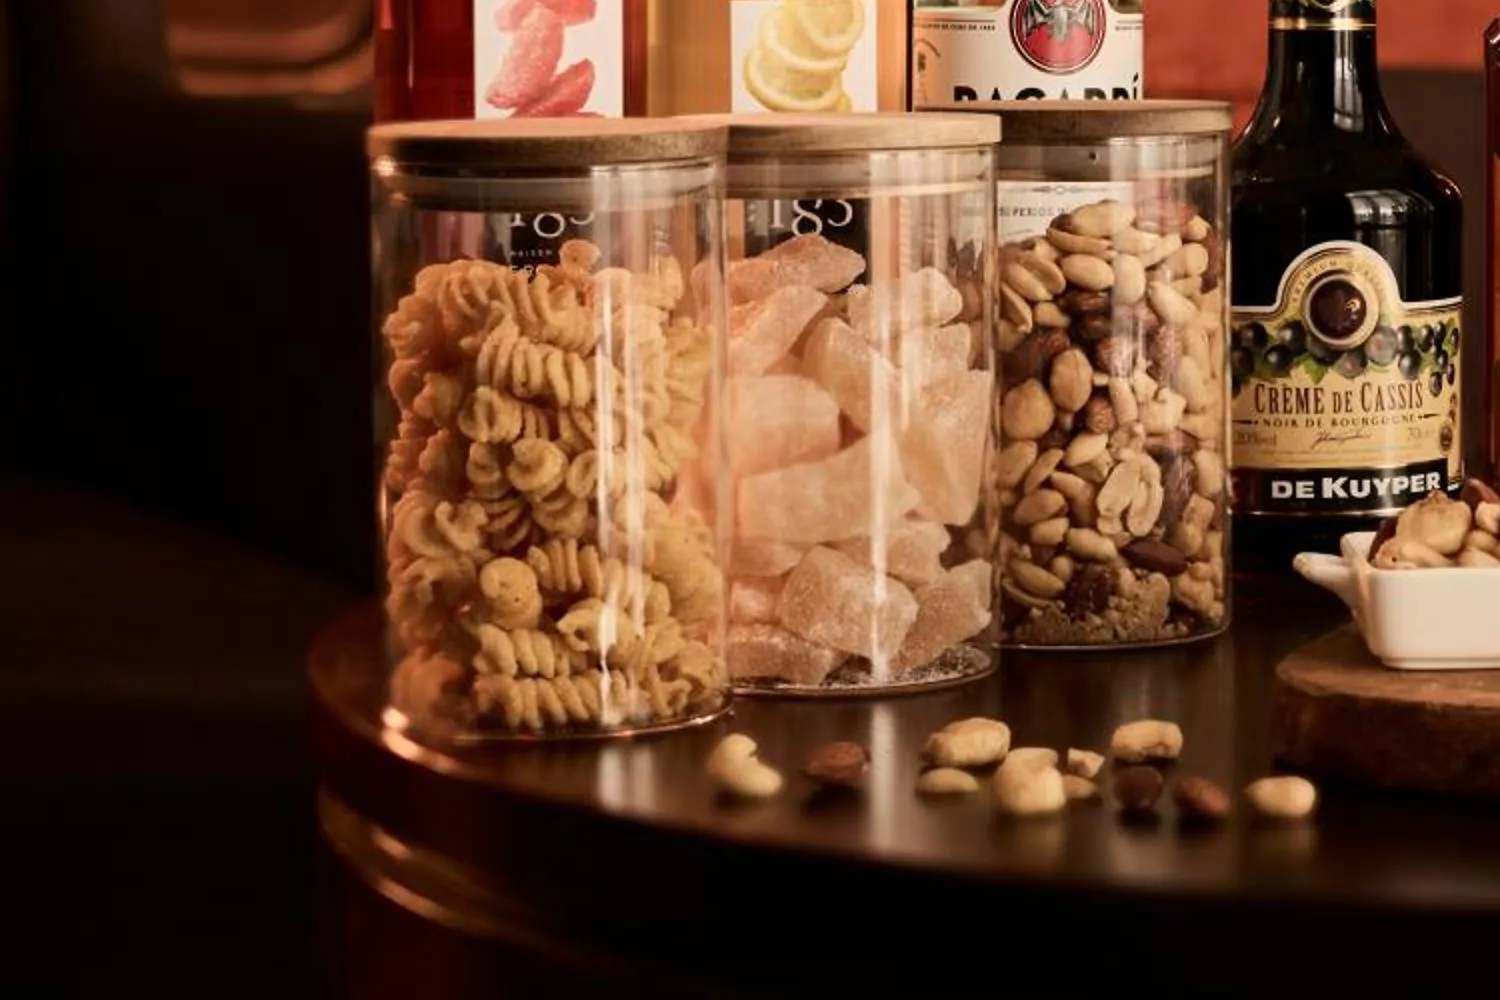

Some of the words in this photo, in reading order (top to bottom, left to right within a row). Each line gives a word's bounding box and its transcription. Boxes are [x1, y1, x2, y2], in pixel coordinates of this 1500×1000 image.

[1254, 382, 1325, 415] CRÈME
[1360, 380, 1424, 411] CASSIS
[1263, 416, 1298, 428] NOIR
[1305, 415, 1324, 428] DE
[1271, 479, 1315, 499] DE
[1321, 471, 1441, 499] KUYPER
